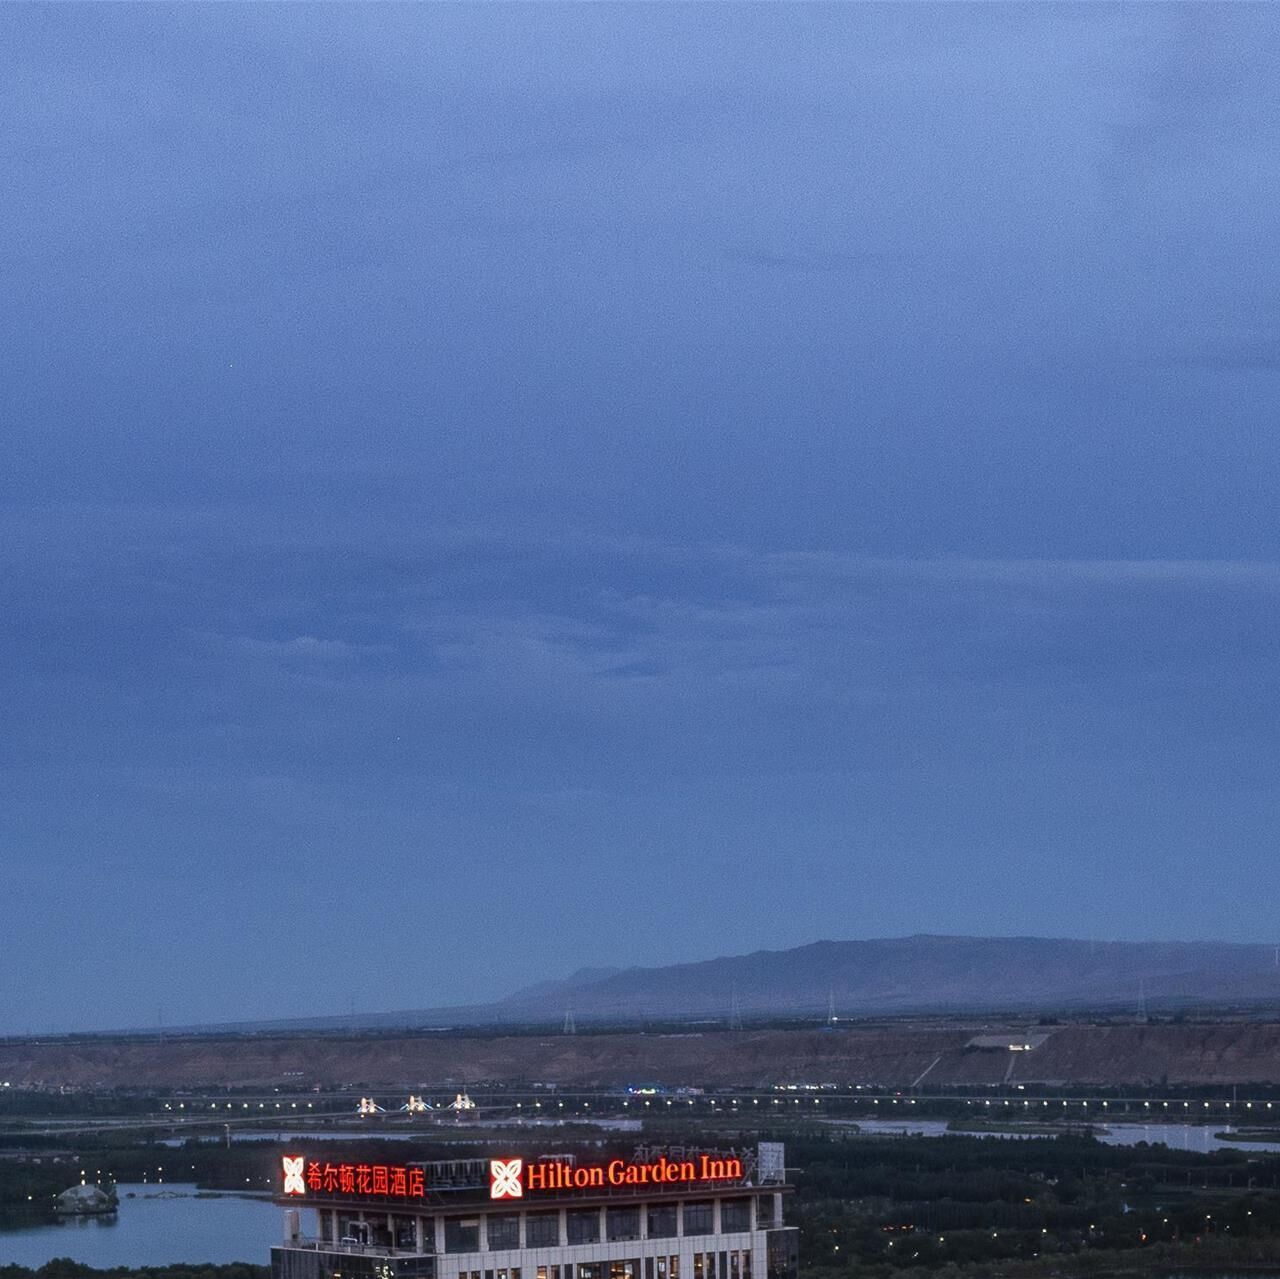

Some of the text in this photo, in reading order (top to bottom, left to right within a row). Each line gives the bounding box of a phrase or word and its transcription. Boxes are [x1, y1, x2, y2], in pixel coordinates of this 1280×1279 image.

[307, 1161, 425, 1197] 希尔顿花园酒店
[527, 1162, 604, 1190] Hilton
[608, 1158, 696, 1185] Garden
[700, 1155, 742, 1180] Inn
